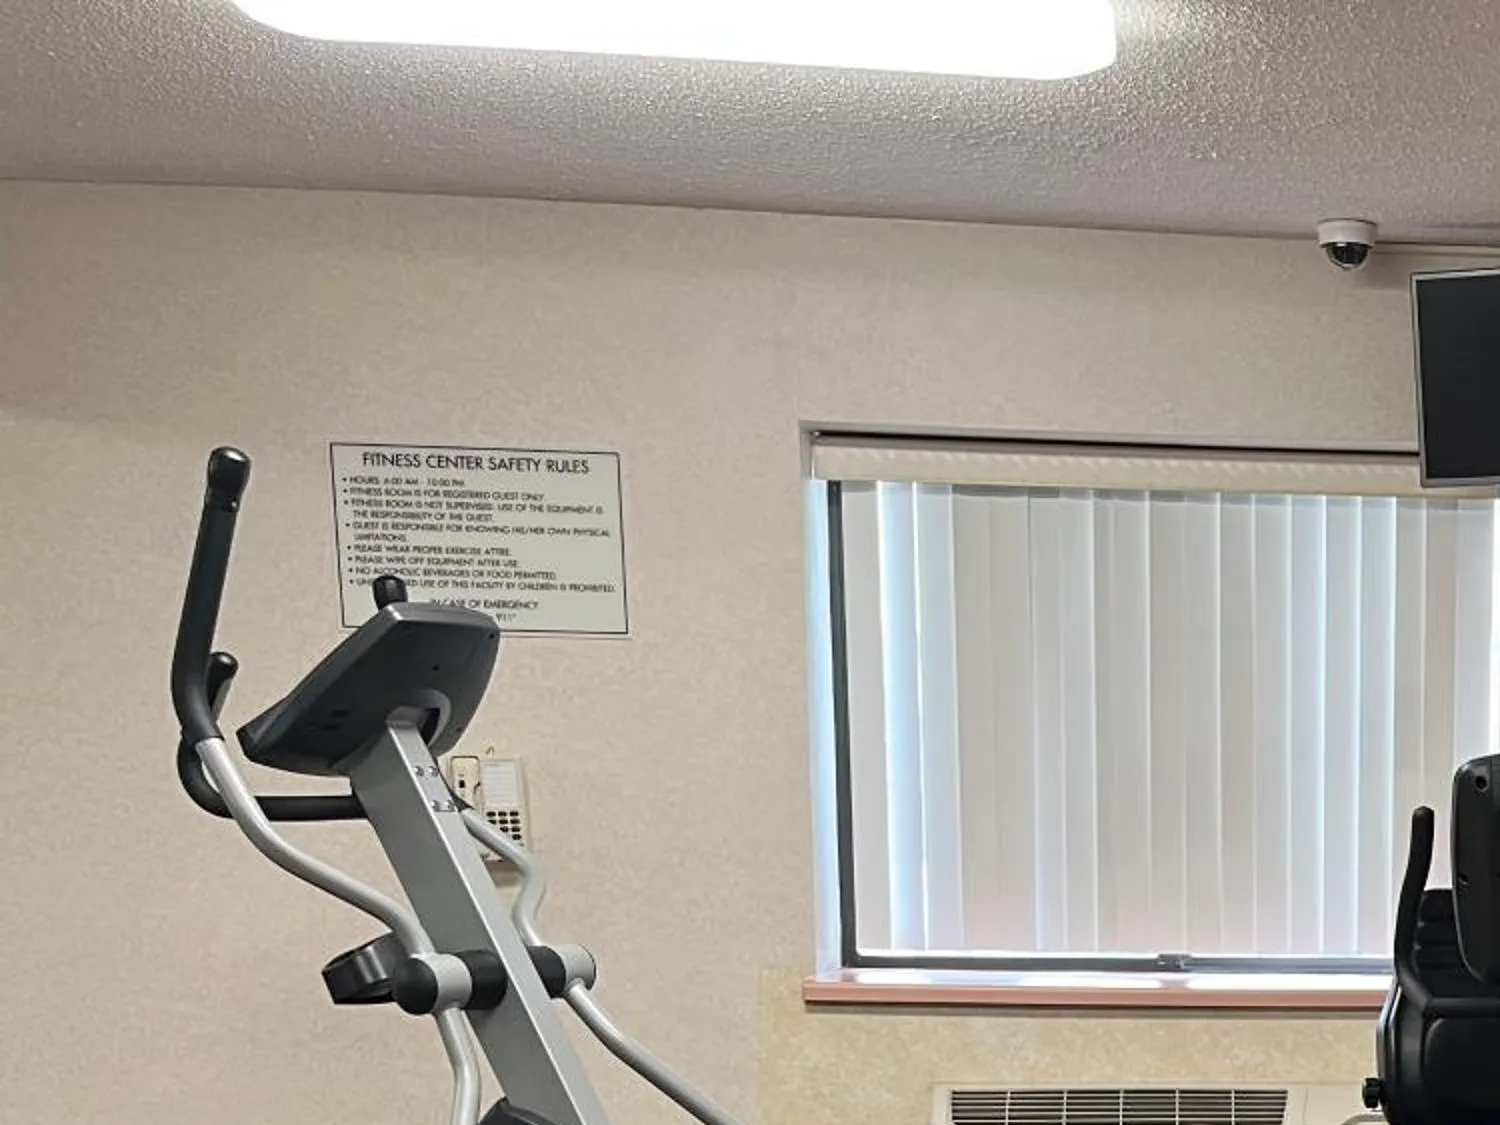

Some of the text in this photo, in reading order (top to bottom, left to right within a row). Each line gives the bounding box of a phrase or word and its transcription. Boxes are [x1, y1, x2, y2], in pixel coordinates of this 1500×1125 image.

[363, 452, 589, 474] FITNESS CENTER SAFETY RULES
[350, 487, 383, 496] FITNESS
[384, 488, 413, 497] ROOM
[424, 489, 441, 498] FOR
[492, 491, 519, 501] GUEST
[355, 566, 371, 574] NO
